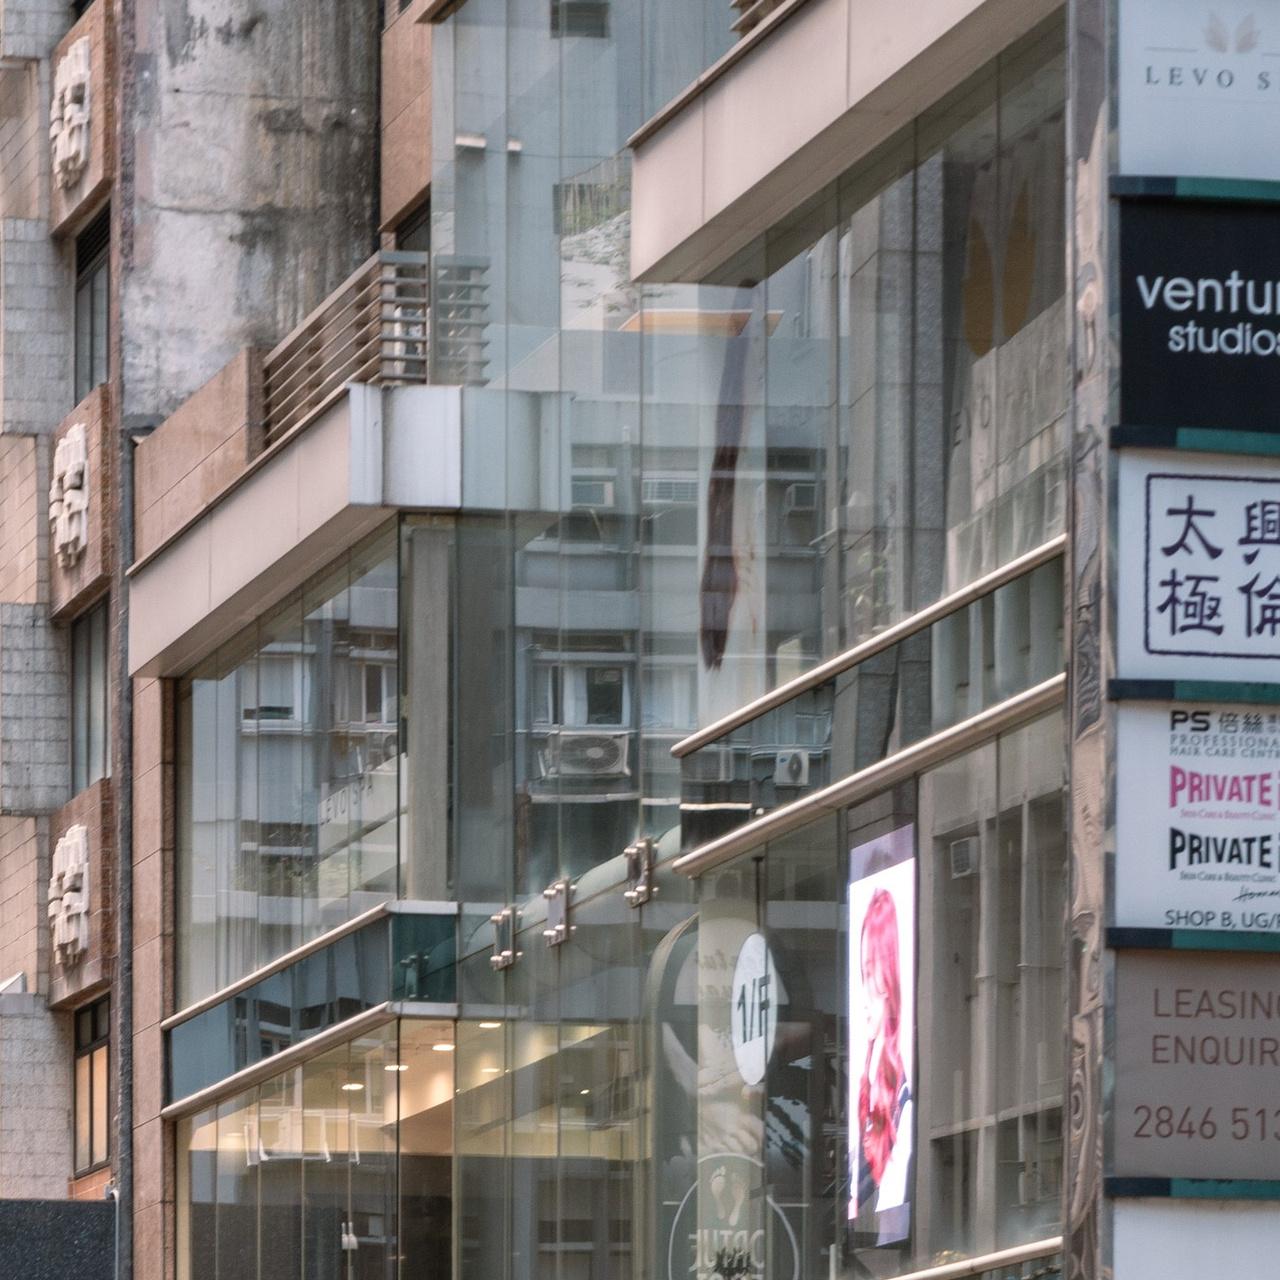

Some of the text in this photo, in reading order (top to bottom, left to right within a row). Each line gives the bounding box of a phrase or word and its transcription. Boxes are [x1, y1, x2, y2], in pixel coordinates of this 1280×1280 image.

[1145, 65, 1280, 91] LEVO S
[1136, 270, 1280, 315] ventu
[1170, 710, 1211, 732] PS
[1169, 765, 1272, 808] PRIVATE
[1169, 827, 1272, 871] PRIVATE
[1165, 909, 1216, 927] SHOP
[1241, 912, 1280, 929] UG/
[737, 973, 772, 1044] 1/F
[1154, 988, 1280, 1020] LEASIN
[1152, 1034, 1280, 1067] ENQUIR
[1133, 1104, 1218, 1140] 2846
